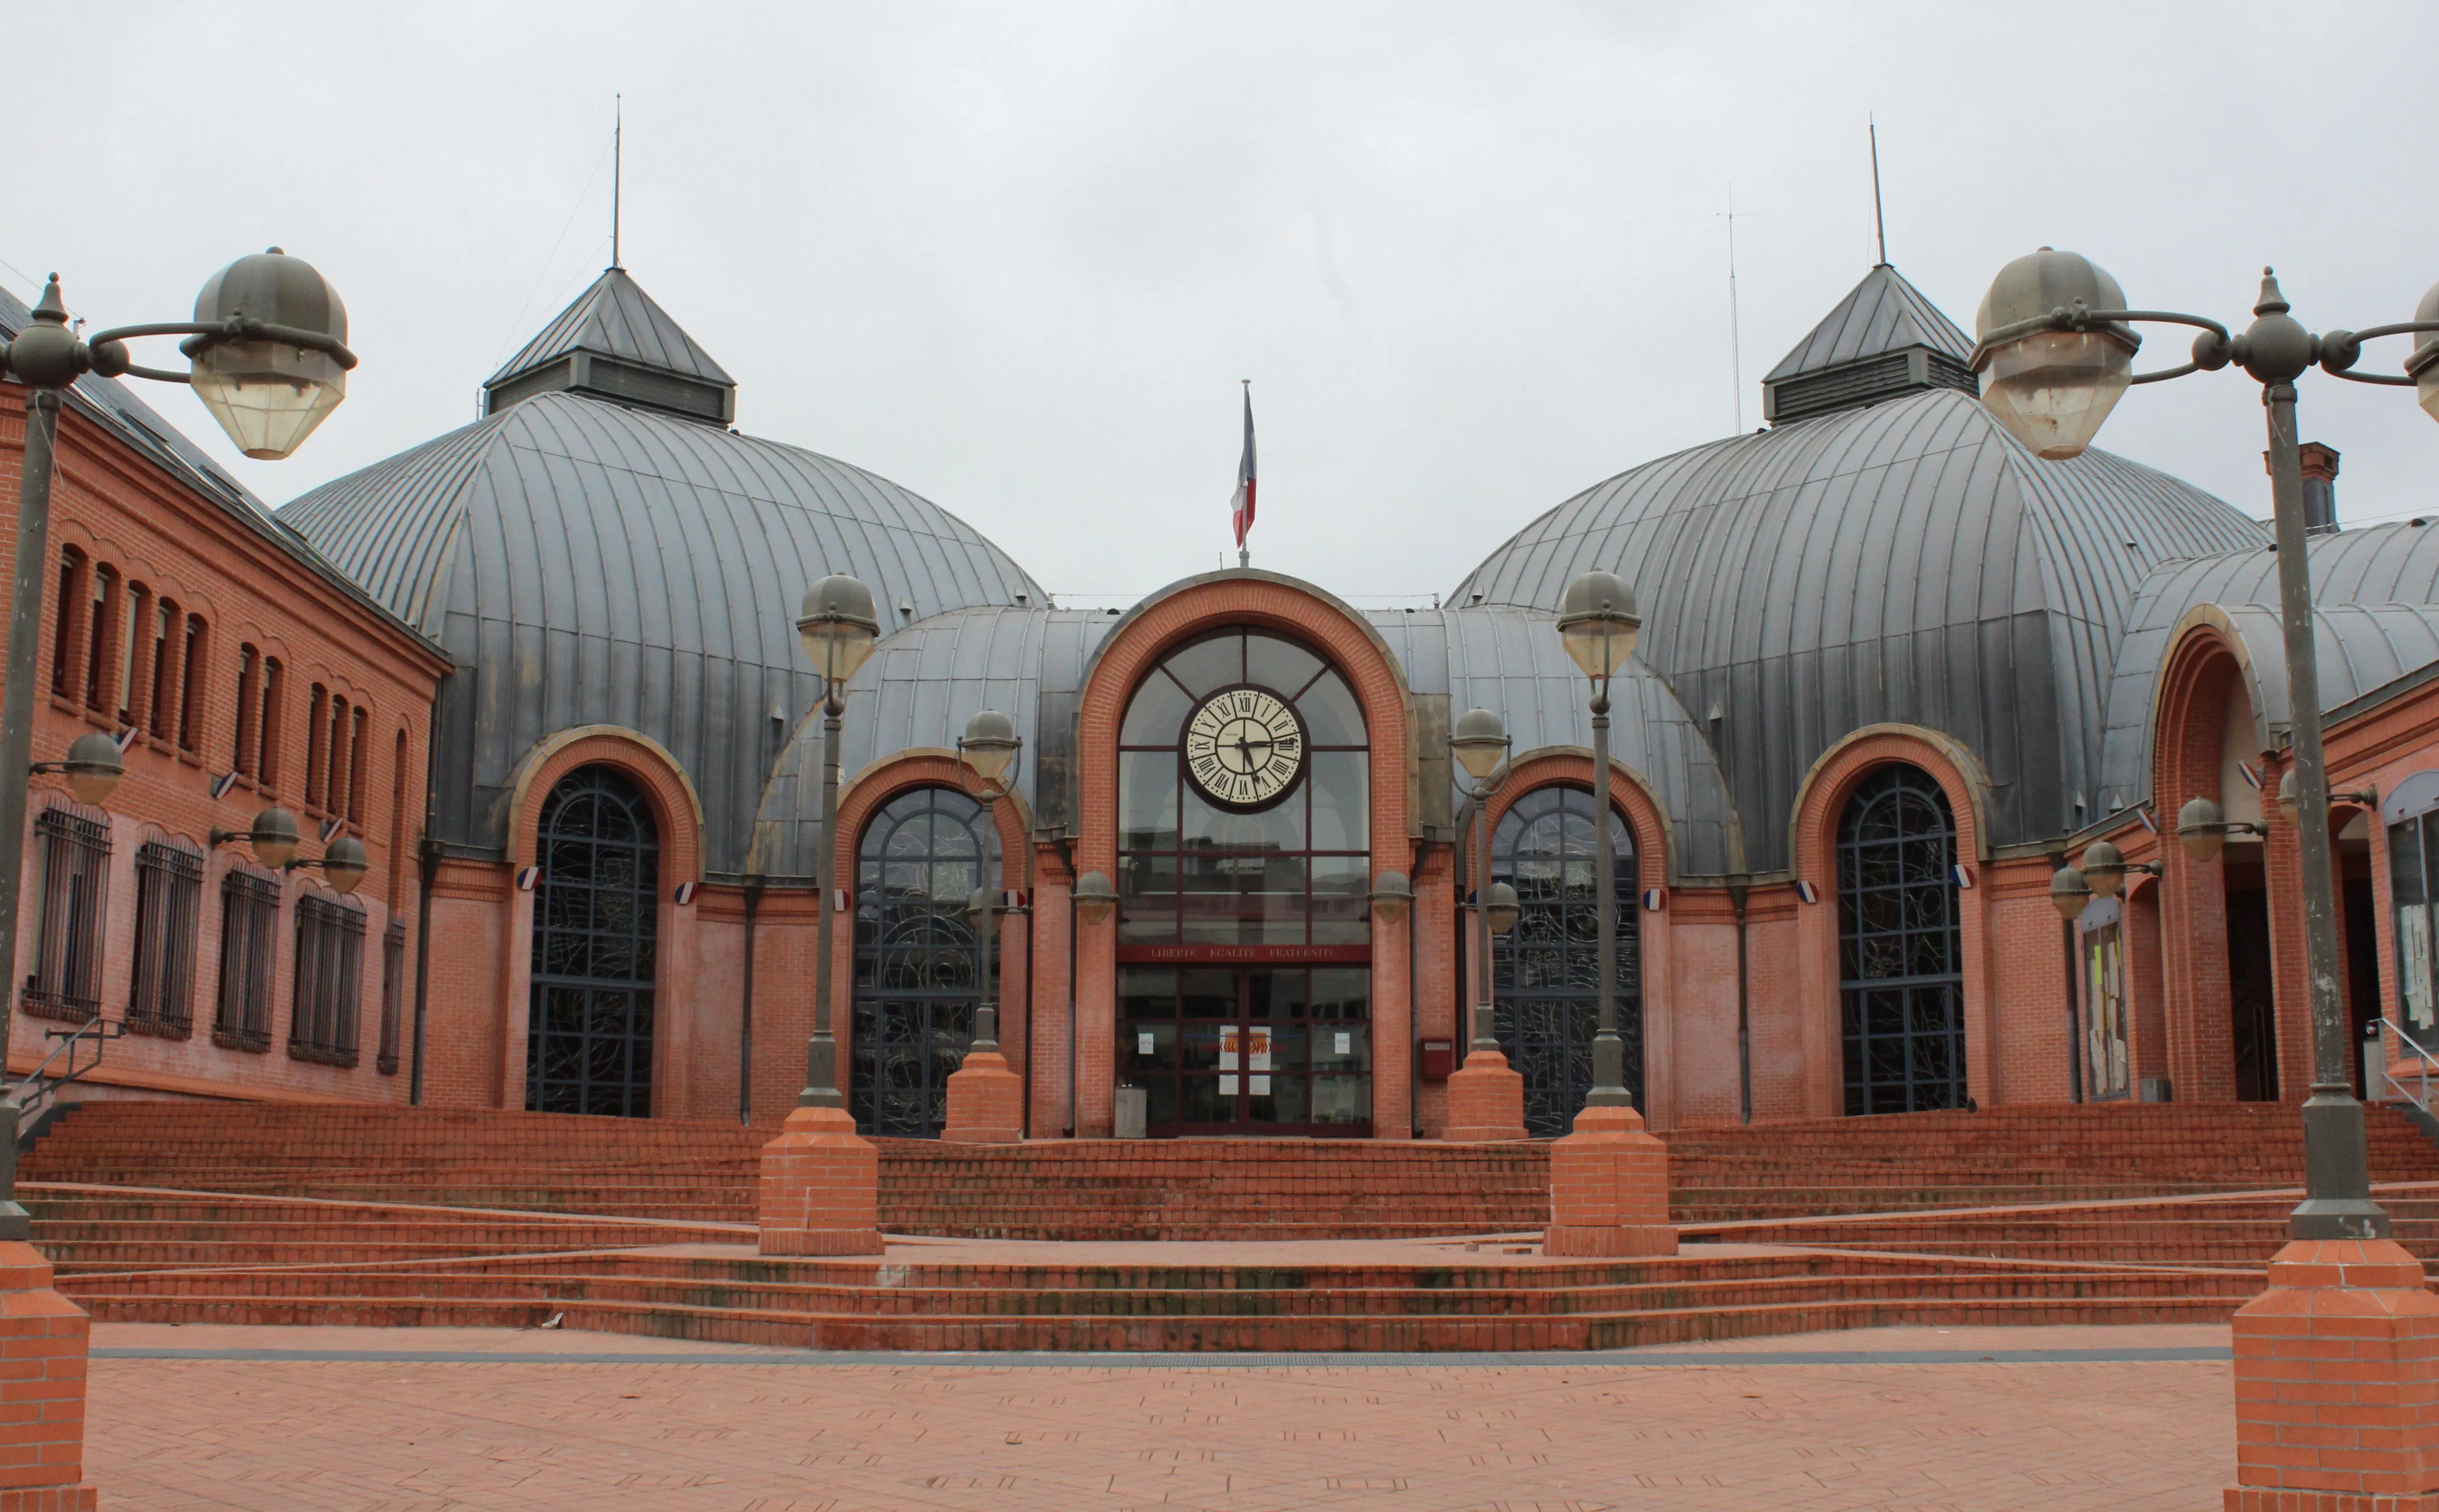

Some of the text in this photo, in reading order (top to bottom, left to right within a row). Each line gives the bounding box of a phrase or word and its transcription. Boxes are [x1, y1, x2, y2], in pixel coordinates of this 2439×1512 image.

[1216, 702, 1231, 718] XI
[1238, 697, 1250, 712] XII
[1260, 704, 1271, 717] I
[1201, 719, 1216, 732] X
[1273, 720, 1289, 732] II
[1195, 741, 1210, 750] IX
[1198, 757, 1216, 775] VIII
[1214, 773, 1229, 791] VII
[1239, 780, 1248, 795] VI
[1261, 776, 1271, 790] V
[1152, 948, 1336, 958] LIBERTE EGALITE FRATERNITE
